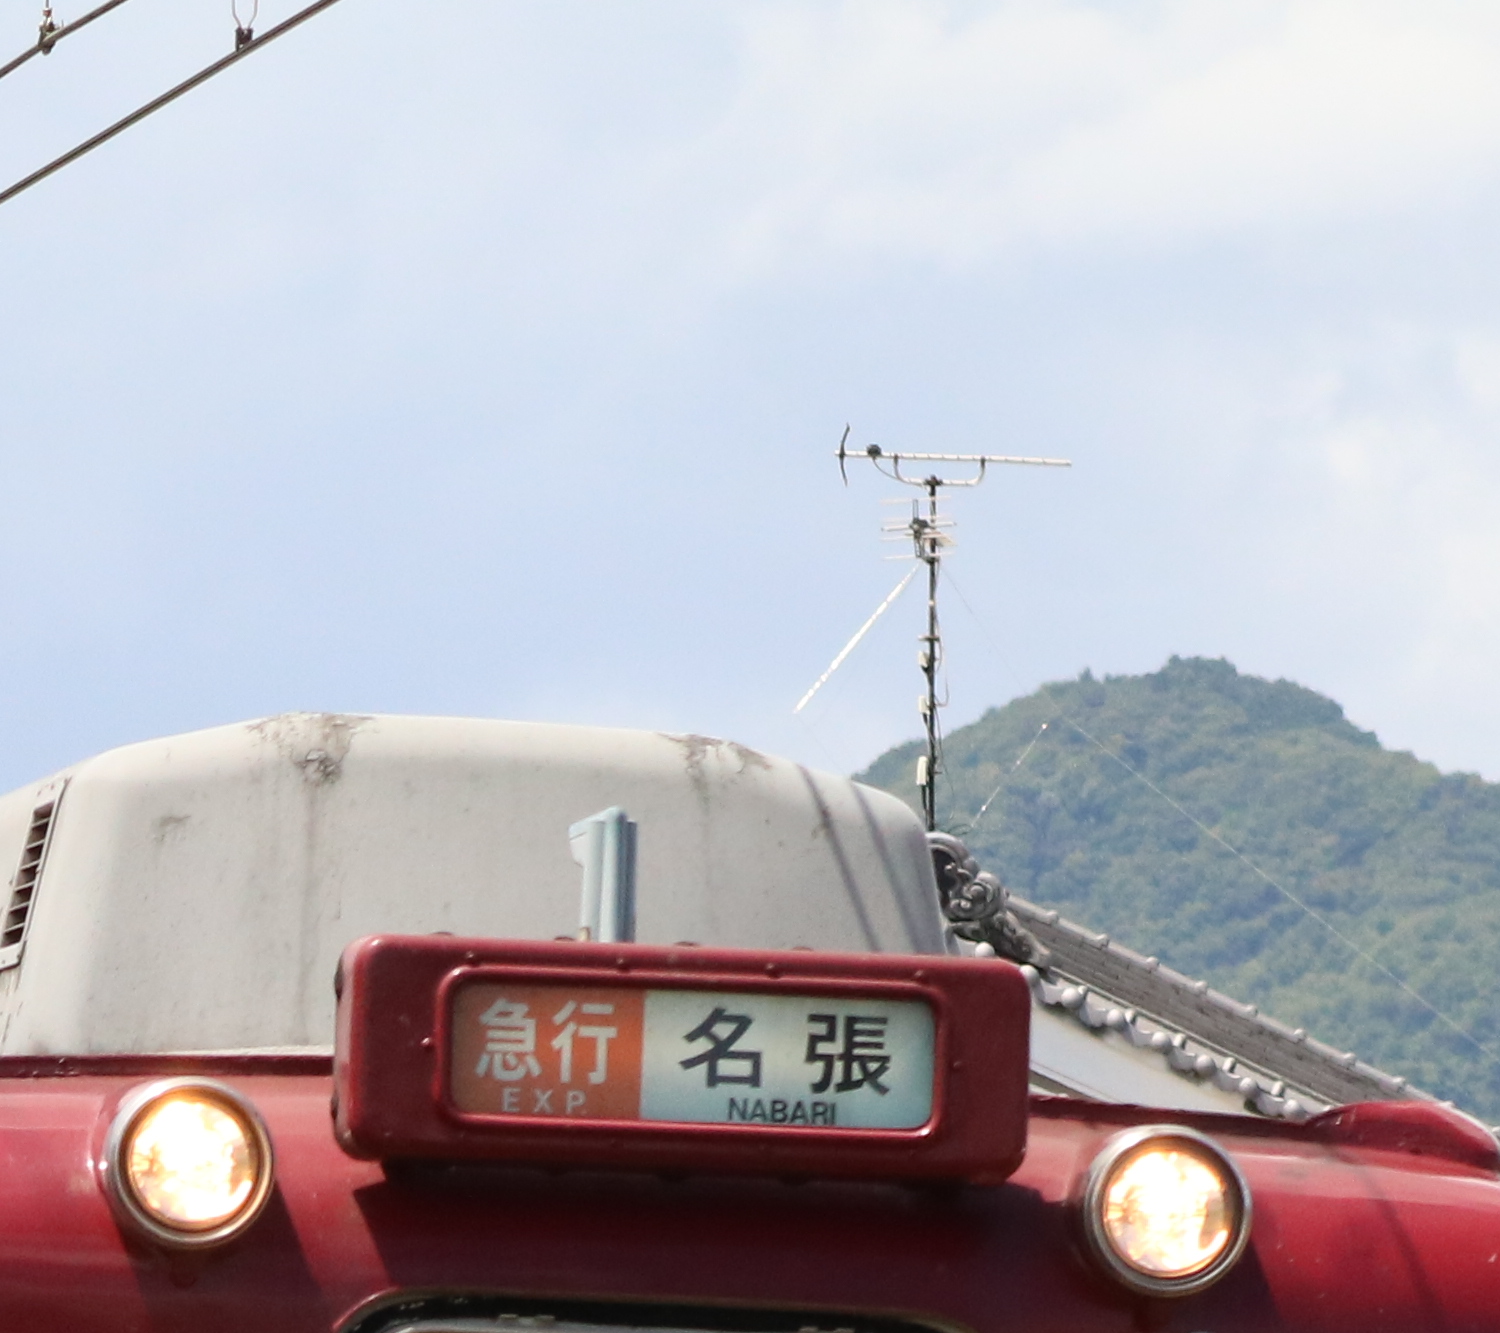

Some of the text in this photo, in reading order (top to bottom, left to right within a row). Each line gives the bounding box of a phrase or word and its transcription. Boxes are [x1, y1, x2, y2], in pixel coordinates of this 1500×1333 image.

[475, 998, 619, 1085] 急行
[678, 1006, 892, 1096] 名張
[727, 1098, 837, 1126] NABARI
